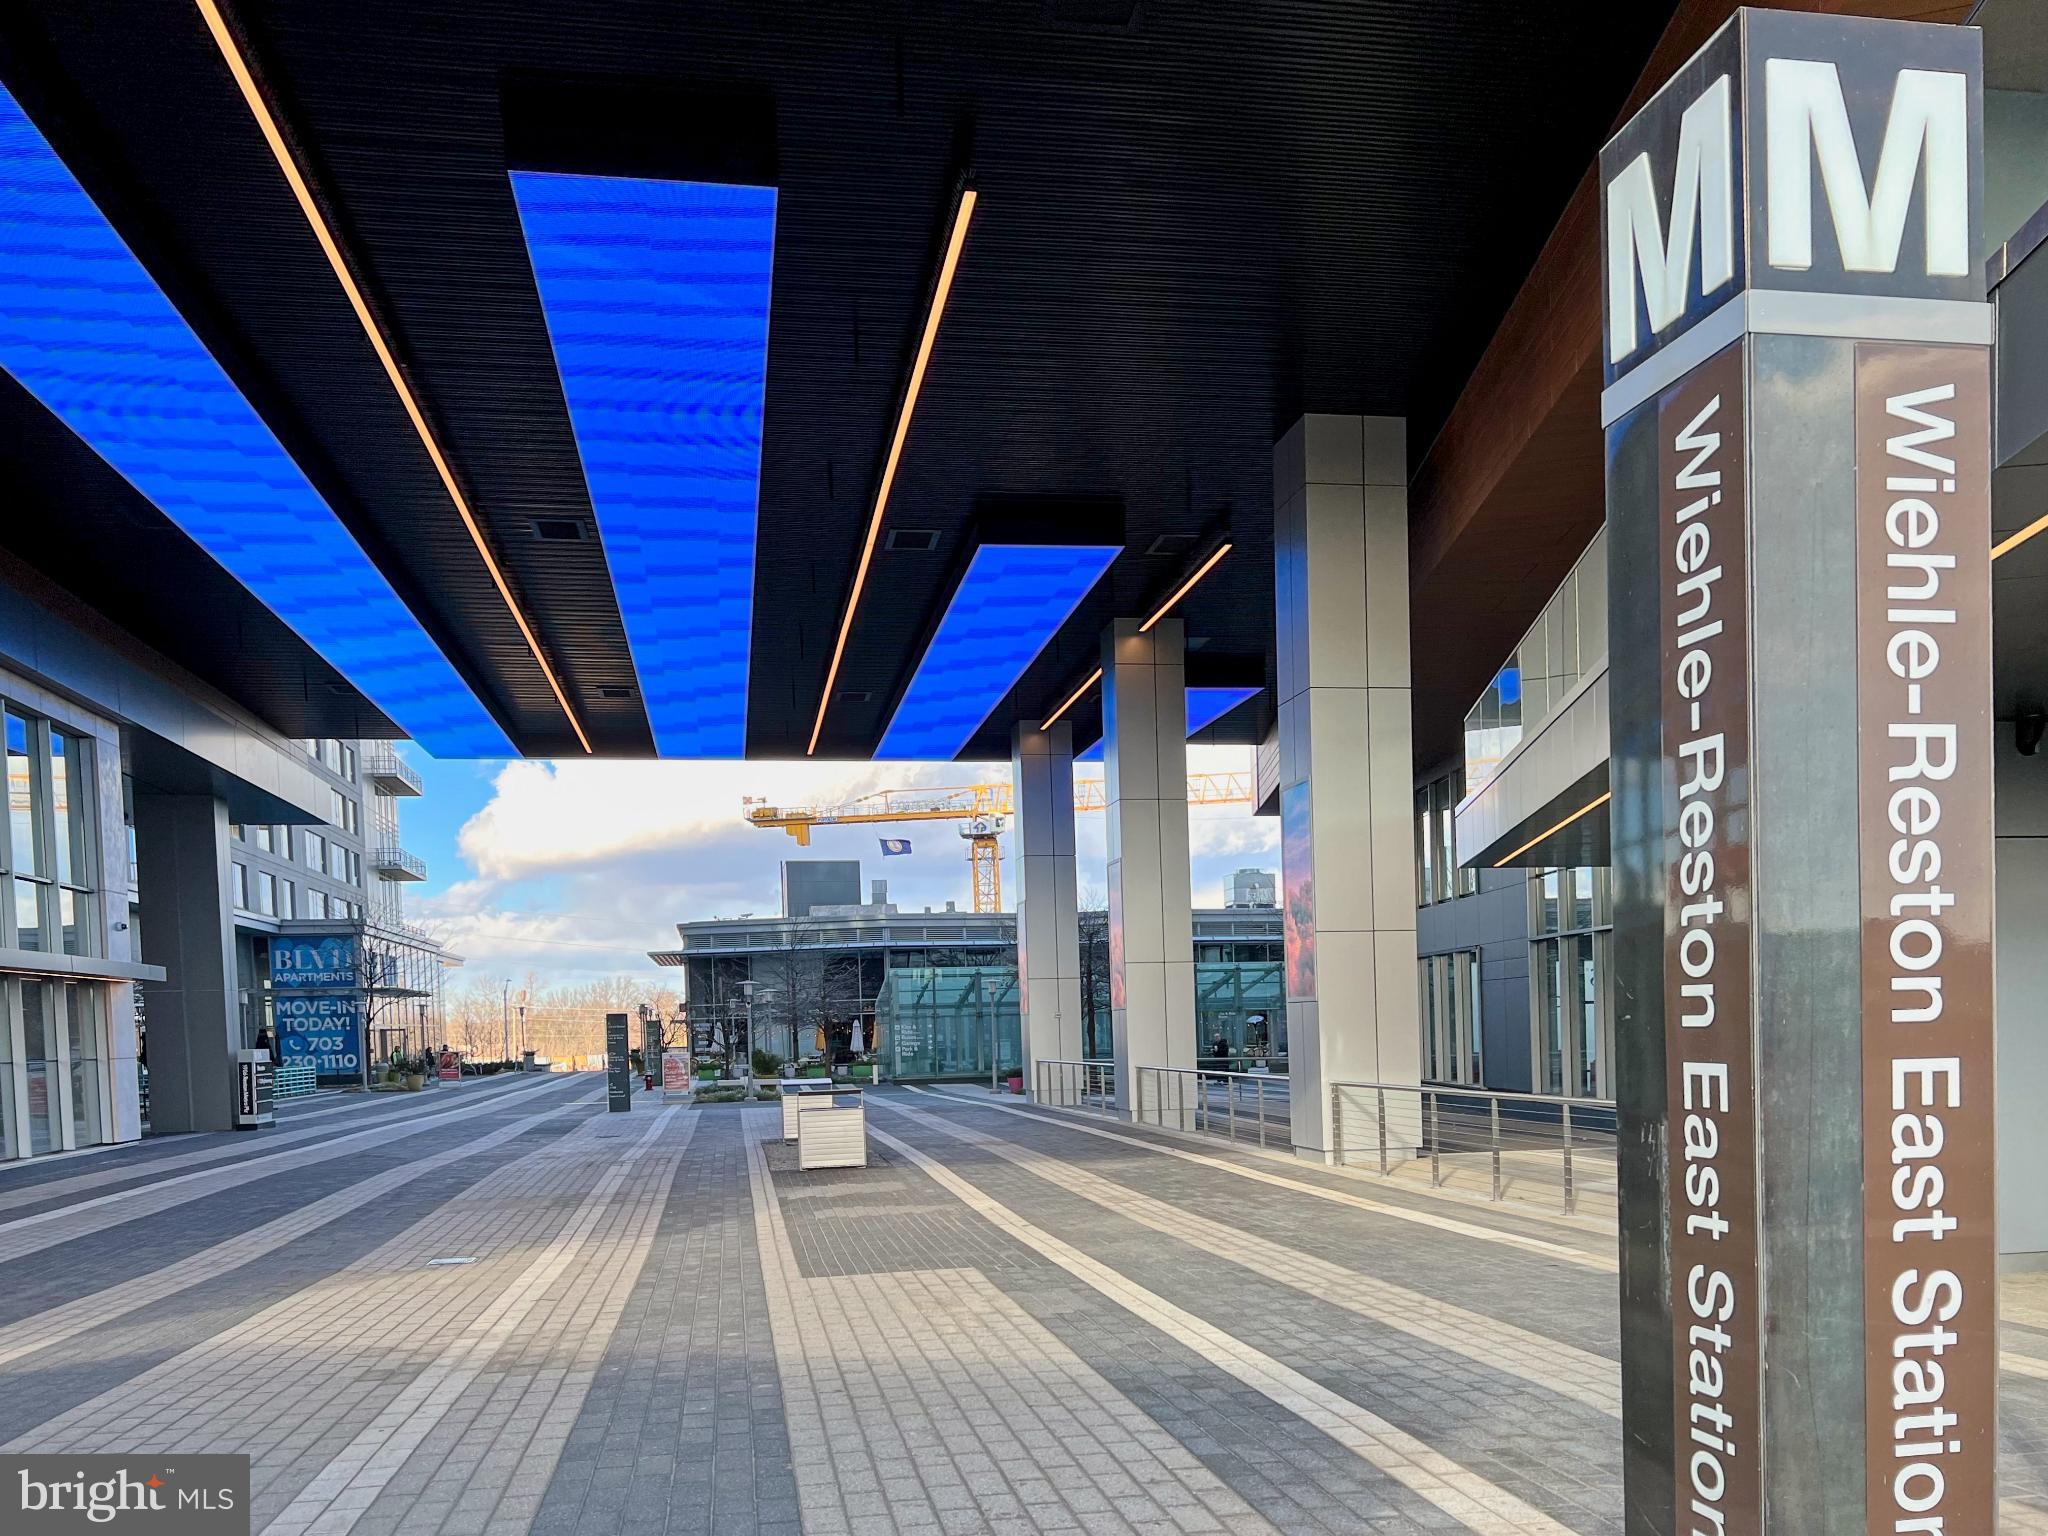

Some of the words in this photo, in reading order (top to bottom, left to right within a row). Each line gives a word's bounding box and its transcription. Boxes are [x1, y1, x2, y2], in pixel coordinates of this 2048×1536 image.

[1607, 74, 1733, 365] M
[1766, 57, 1968, 277] M
[1675, 394, 1725, 1028] Wiehle-Reston
[1886, 383, 1958, 1023] Wiehle-Reston
[274, 972, 354, 982] APARTMENTS
[276, 1001, 356, 1015] MOVE-IN
[283, 1017, 350, 1032] TODAY!
[307, 1036, 344, 1051] 703
[1683, 1061, 1730, 1241] East
[1891, 1057, 1961, 1242] East
